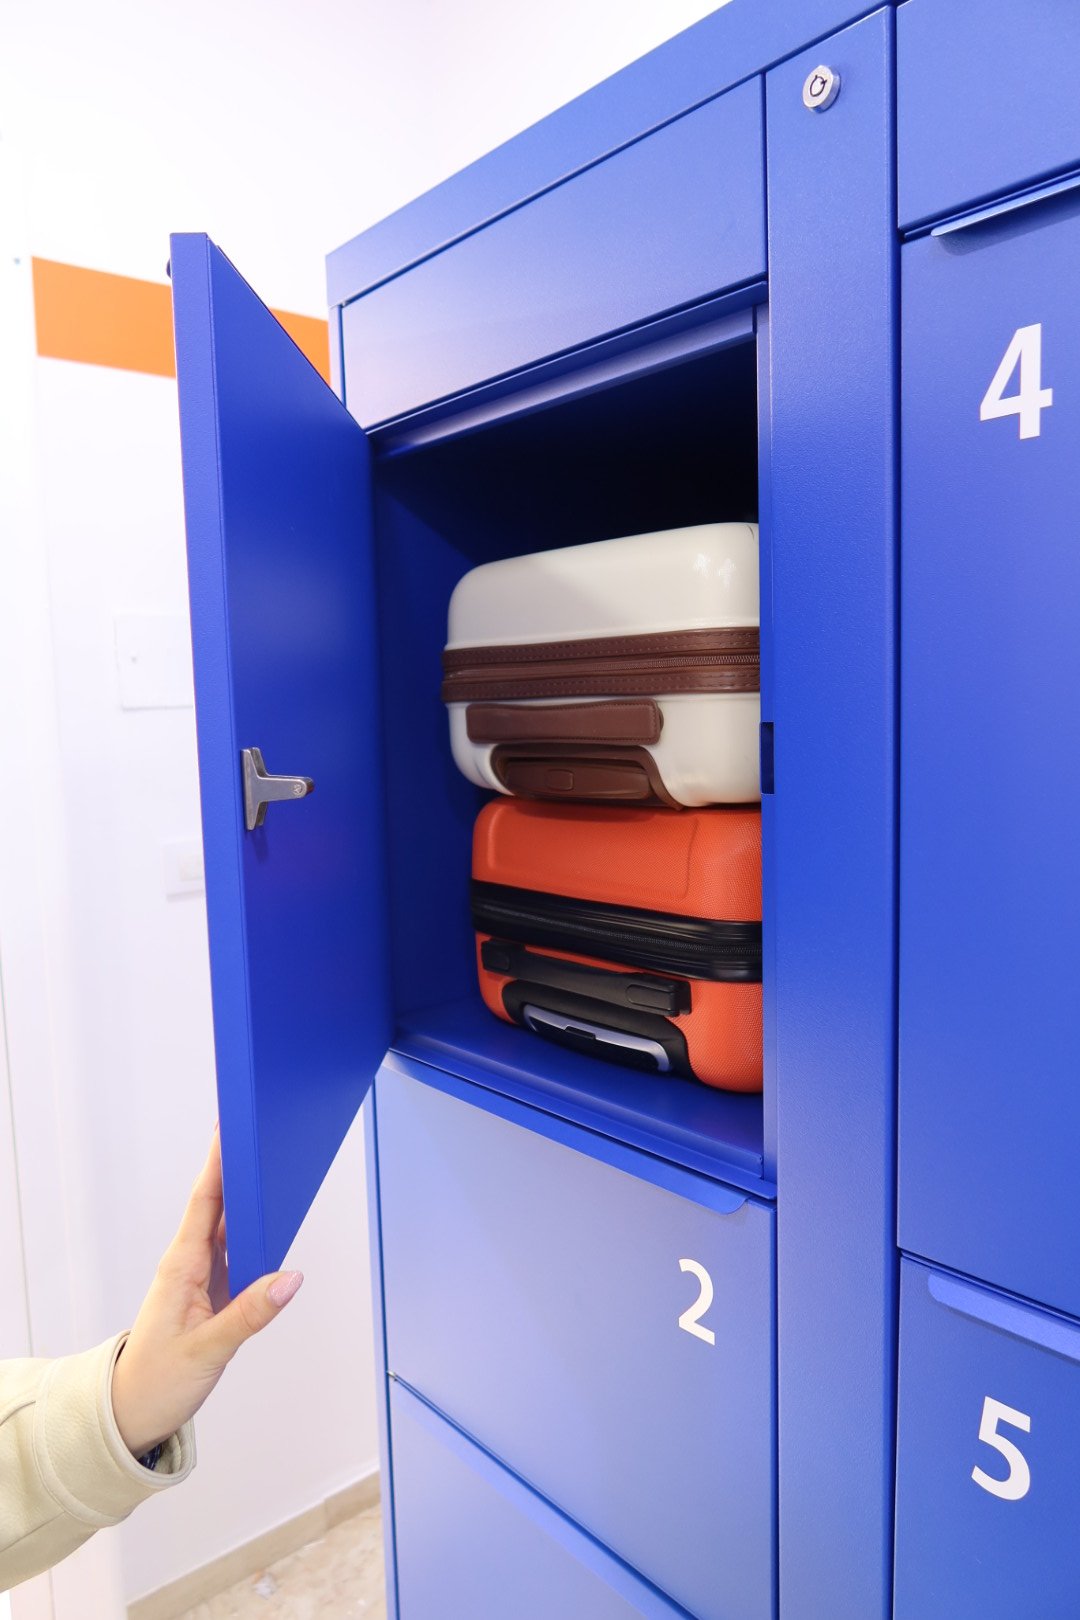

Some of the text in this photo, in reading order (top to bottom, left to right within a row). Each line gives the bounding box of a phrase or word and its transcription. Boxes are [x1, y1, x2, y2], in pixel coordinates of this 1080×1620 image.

[979, 323, 1053, 439] 4
[678, 1258, 715, 1345] 2
[971, 1397, 1031, 1500] 5
